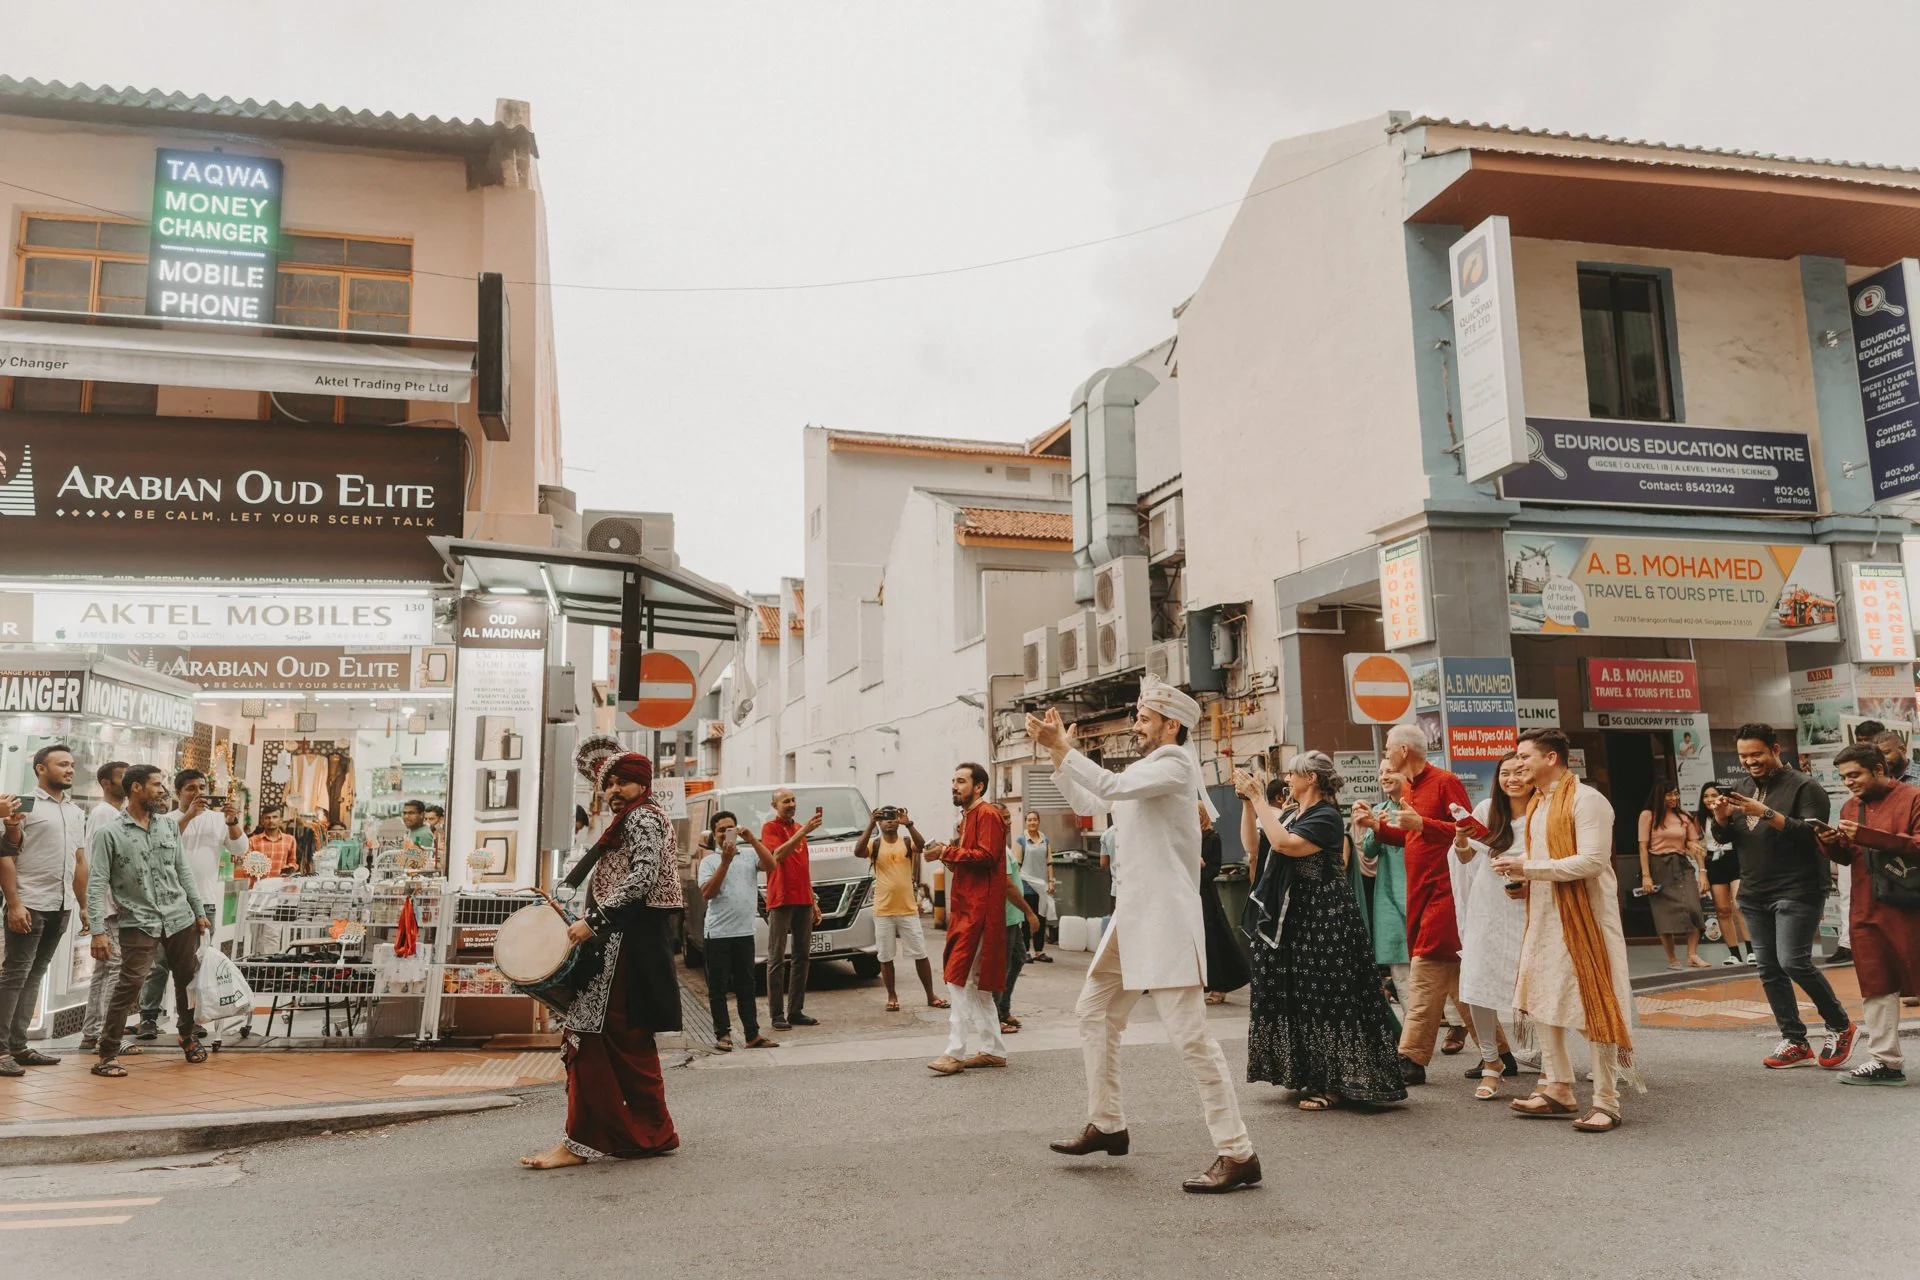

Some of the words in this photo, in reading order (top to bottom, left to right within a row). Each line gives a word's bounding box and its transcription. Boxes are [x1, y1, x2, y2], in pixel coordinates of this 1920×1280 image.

[167, 159, 269, 189] TAQWA
[165, 191, 268, 218] MONEY
[159, 217, 268, 244] CHANGER
[159, 260, 264, 288] MOBILE
[160, 291, 259, 319] PHONE
[1860, 324, 1906, 349] EDURIOUS
[1859, 333, 1911, 361] EDUCATION
[10, 357, 69, 371] Changer
[1868, 348, 1904, 368] CENTRE
[1893, 370, 1915, 382] LEVEL
[315, 376, 348, 387] Aktel
[353, 378, 400, 392] Trading
[405, 381, 425, 391] Pte
[429, 383, 448, 393] Ltd
[1888, 380, 1909, 392] LEVEL
[1877, 396, 1906, 411] SCIENCE
[1879, 391, 1902, 403] MATHS
[1876, 420, 1913, 437] Contact:
[1875, 428, 1917, 448] 85421242
[1554, 433, 1640, 453] EDURIOUS
[1644, 439, 1739, 458] EDUCATION
[1742, 444, 1805, 462] CENTRE
[1632, 462, 1654, 470] LEVEL
[1741, 468, 1772, 476] SCIENCE
[1885, 464, 1915, 478] #02-06
[1639, 480, 1683, 491] Contact:
[1685, 482, 1735, 494] 85421242
[1774, 486, 1810, 496] #02-06
[134, 510, 156, 519] BE
[230, 512, 262, 522] LET
[272, 514, 319, 524] YOUR
[328, 515, 384, 525] SCENT
[393, 517, 435, 527] TALK
[1586, 552, 1610, 575] A.
[1615, 554, 1637, 576] B.
[1641, 554, 1763, 581] MOHAMED
[1558, 584, 1573, 592] Kind
[1586, 583, 1642, 599] TRAVEL
[1645, 585, 1655, 599] &
[1657, 586, 1706, 601] TOURS
[1741, 589, 1769, 603] LTD.
[80, 603, 211, 625] AKTEL
[227, 605, 393, 627] MOBILES
[404, 604, 425, 612] 130
[489, 614, 517, 625] OUD
[1859, 580, 1882, 656] MONEY
[1883, 580, 1908, 656] CHANGER
[463, 628, 479, 638] AL
[482, 628, 540, 639] MADINAH
[1626, 668, 1684, 683] MOHAMED
[1809, 669, 1831, 680] ABM
[1465, 674, 1511, 693] MOHAMED
[1595, 687, 1623, 698] TRAVEL
[1626, 687, 1632, 697] &
[1634, 687, 1658, 698] TOURS
[88, 680, 137, 720] MONEY
[139, 693, 193, 735] CHANGER
[1446, 700, 1468, 712] TRAVEL
[1472, 701, 1491, 713] TOURS
[1518, 708, 1557, 719] CLINIC
[1612, 717, 1622, 725] SG
[1624, 717, 1663, 726] QUICKPAY
[1665, 717, 1679, 726] PTE
[1681, 718, 1694, 726] LTD
[1453, 730, 1467, 741] Here
[1468, 730, 1477, 741] All
[1477, 730, 1495, 743] Types
[1496, 730, 1504, 740] Of
[1504, 730, 1513, 740] Air
[1453, 746, 1475, 757] Tickets
[1475, 746, 1486, 756] Are
[1343, 775, 1378, 783] OMEOP
[811, 933, 823, 943] BH
[810, 943, 830, 952] 29B
